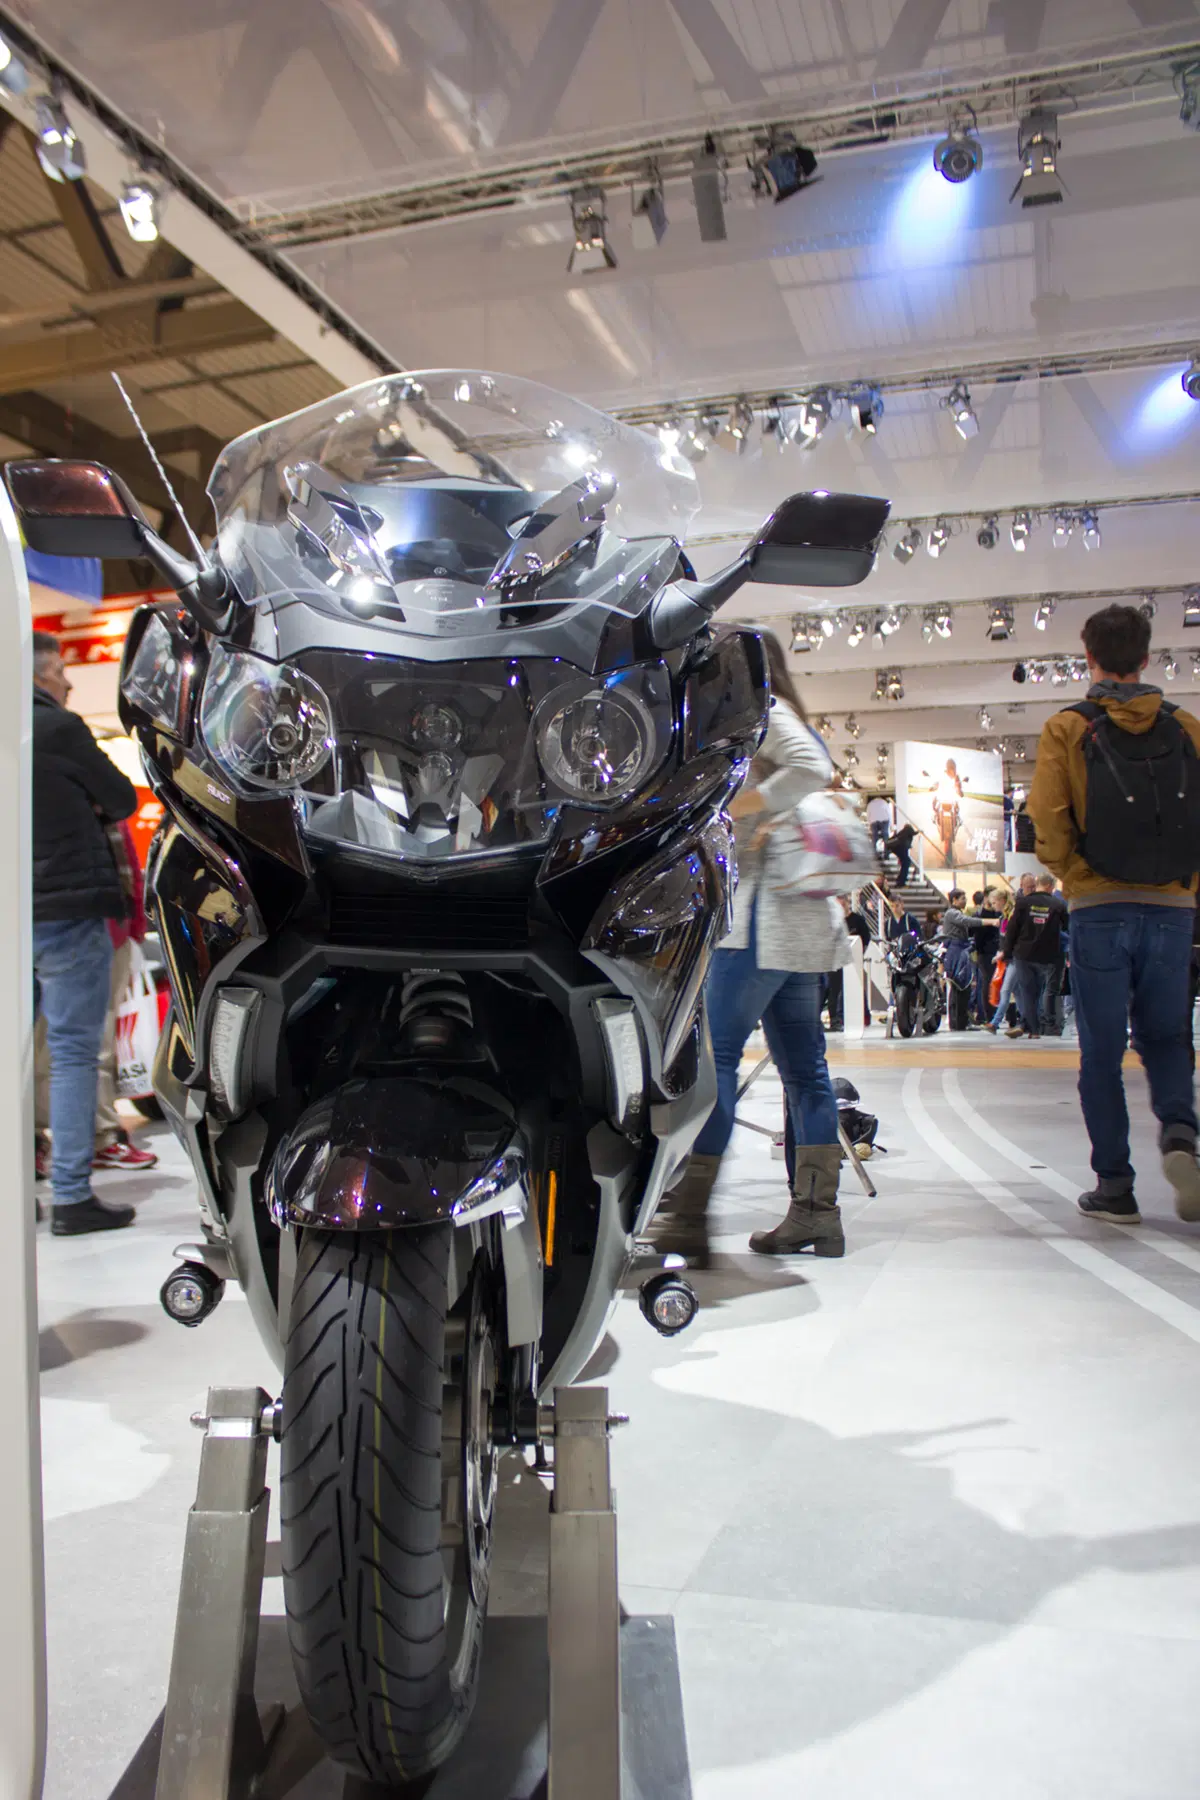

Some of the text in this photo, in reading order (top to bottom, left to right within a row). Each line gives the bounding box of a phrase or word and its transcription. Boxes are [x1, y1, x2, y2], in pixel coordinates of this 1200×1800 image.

[974, 828, 998, 841] MAKE
[966, 838, 991, 851] LIFE A
